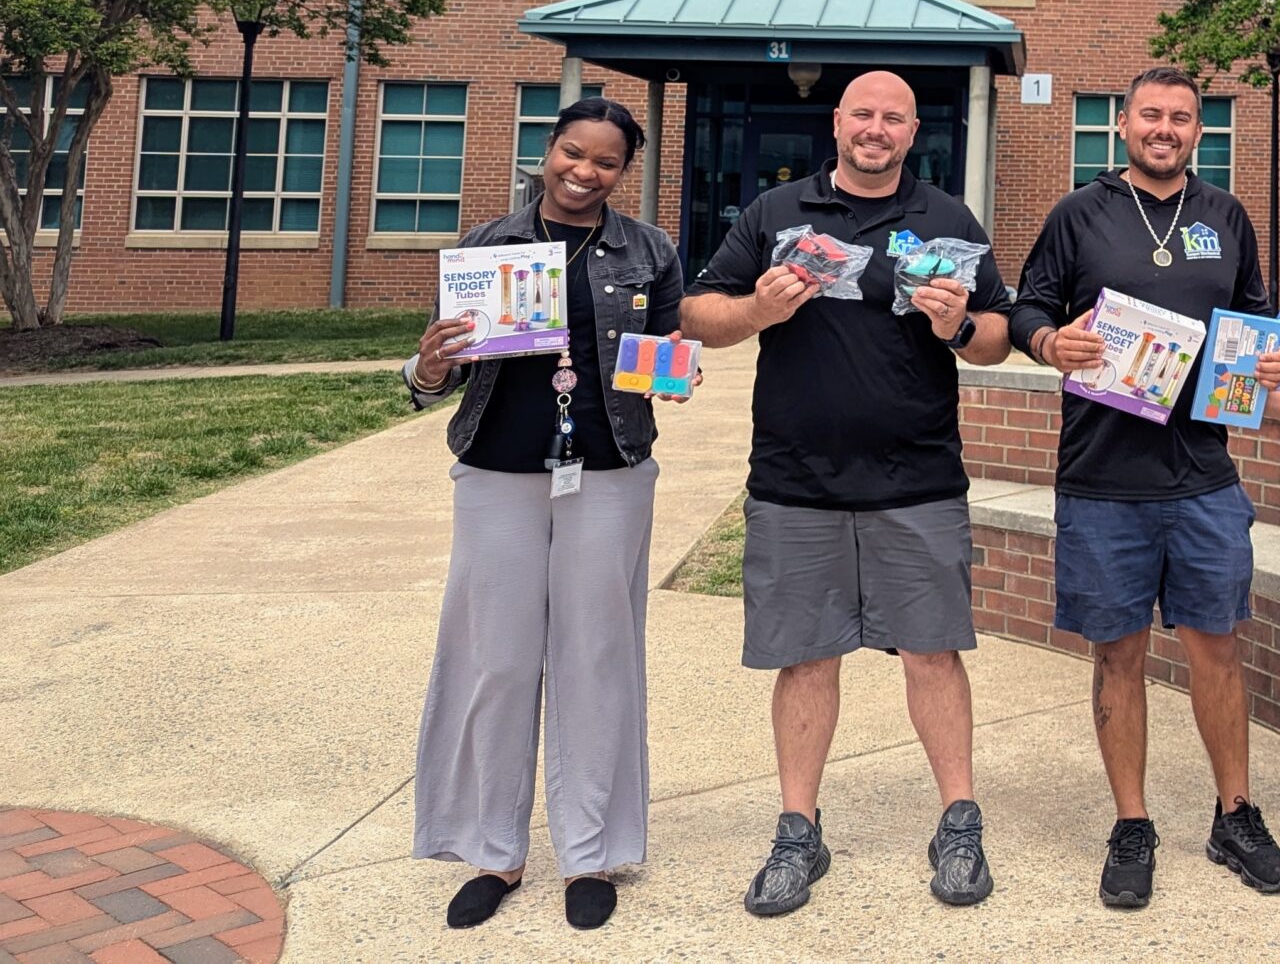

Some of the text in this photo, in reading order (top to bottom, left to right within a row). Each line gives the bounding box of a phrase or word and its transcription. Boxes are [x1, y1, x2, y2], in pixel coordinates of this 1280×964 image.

[769, 41, 789, 59] 31
[1033, 79, 1040, 97] 1
[443, 270, 497, 282] SENSORY
[448, 280, 493, 292] FIDGET
[455, 290, 486, 300] Tubes
[1096, 320, 1141, 342] SENSORY
[1103, 342, 1124, 355] ubes
[1230, 381, 1244, 411] COLOR
[1239, 377, 1255, 412] SHAPE
